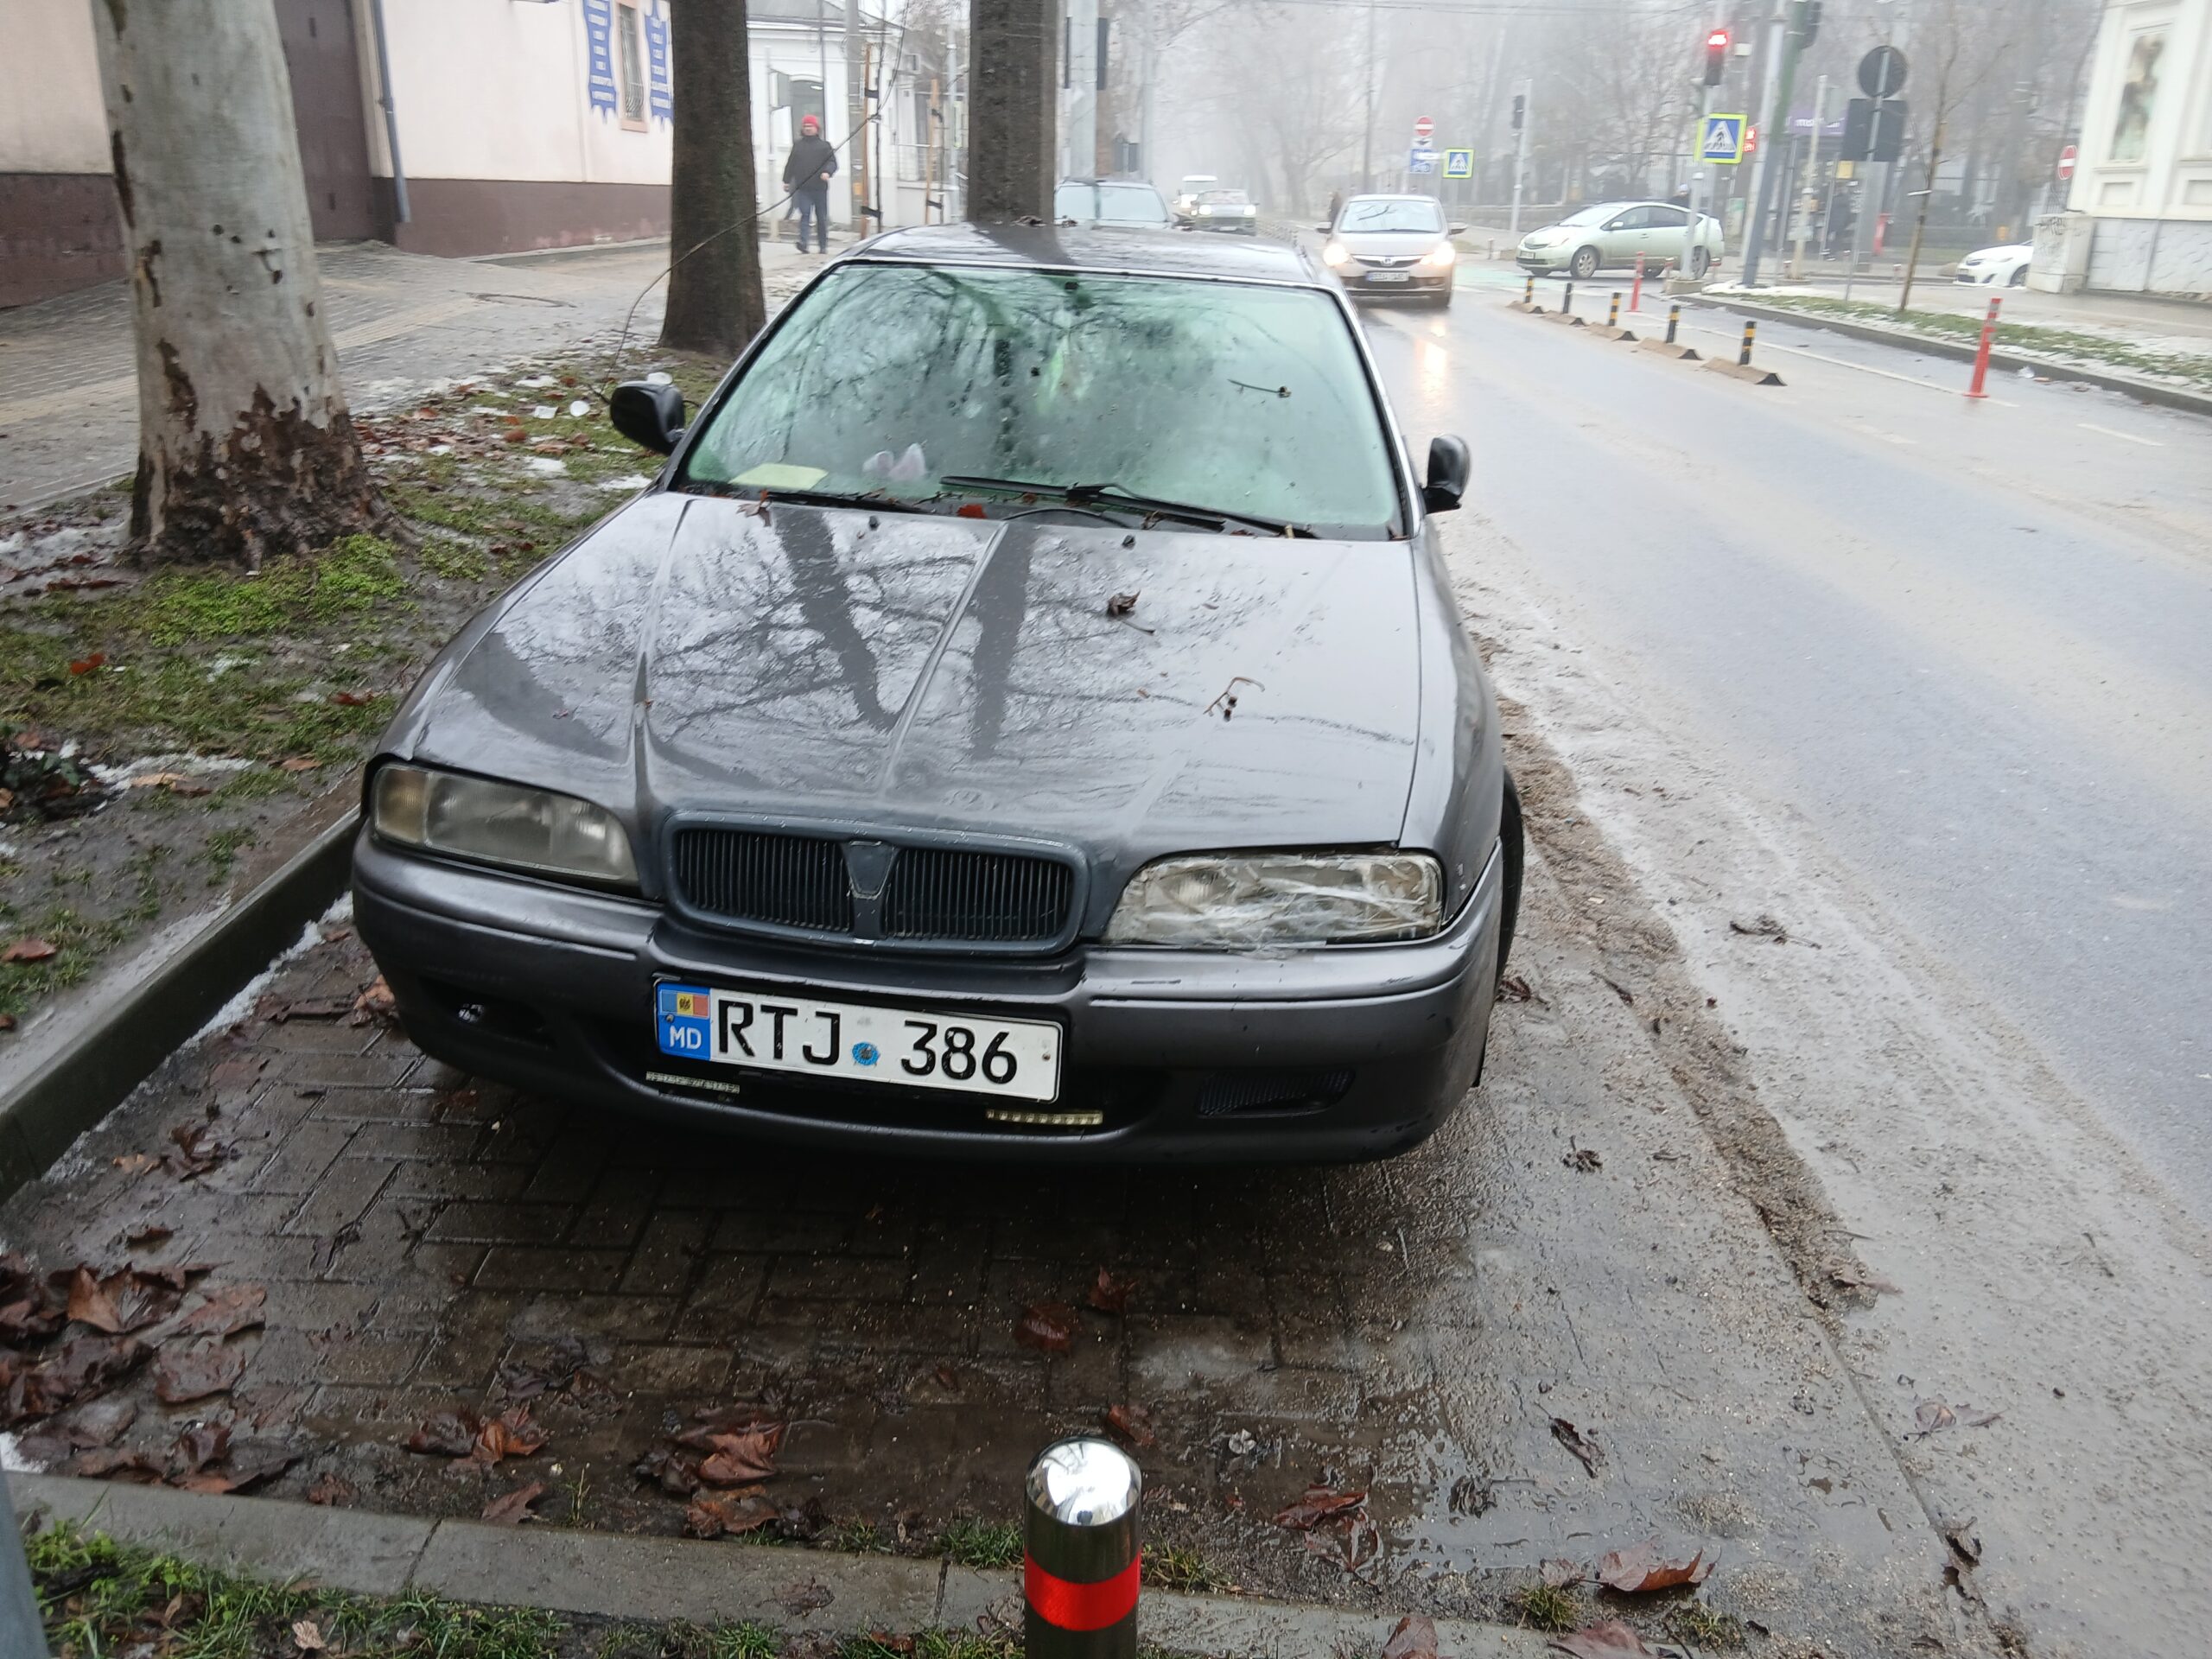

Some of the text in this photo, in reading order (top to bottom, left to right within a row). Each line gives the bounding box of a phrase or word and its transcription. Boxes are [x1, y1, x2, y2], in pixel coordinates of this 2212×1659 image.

[670, 1025, 702, 1050] MD
[719, 999, 1017, 1084] RTJ 386
